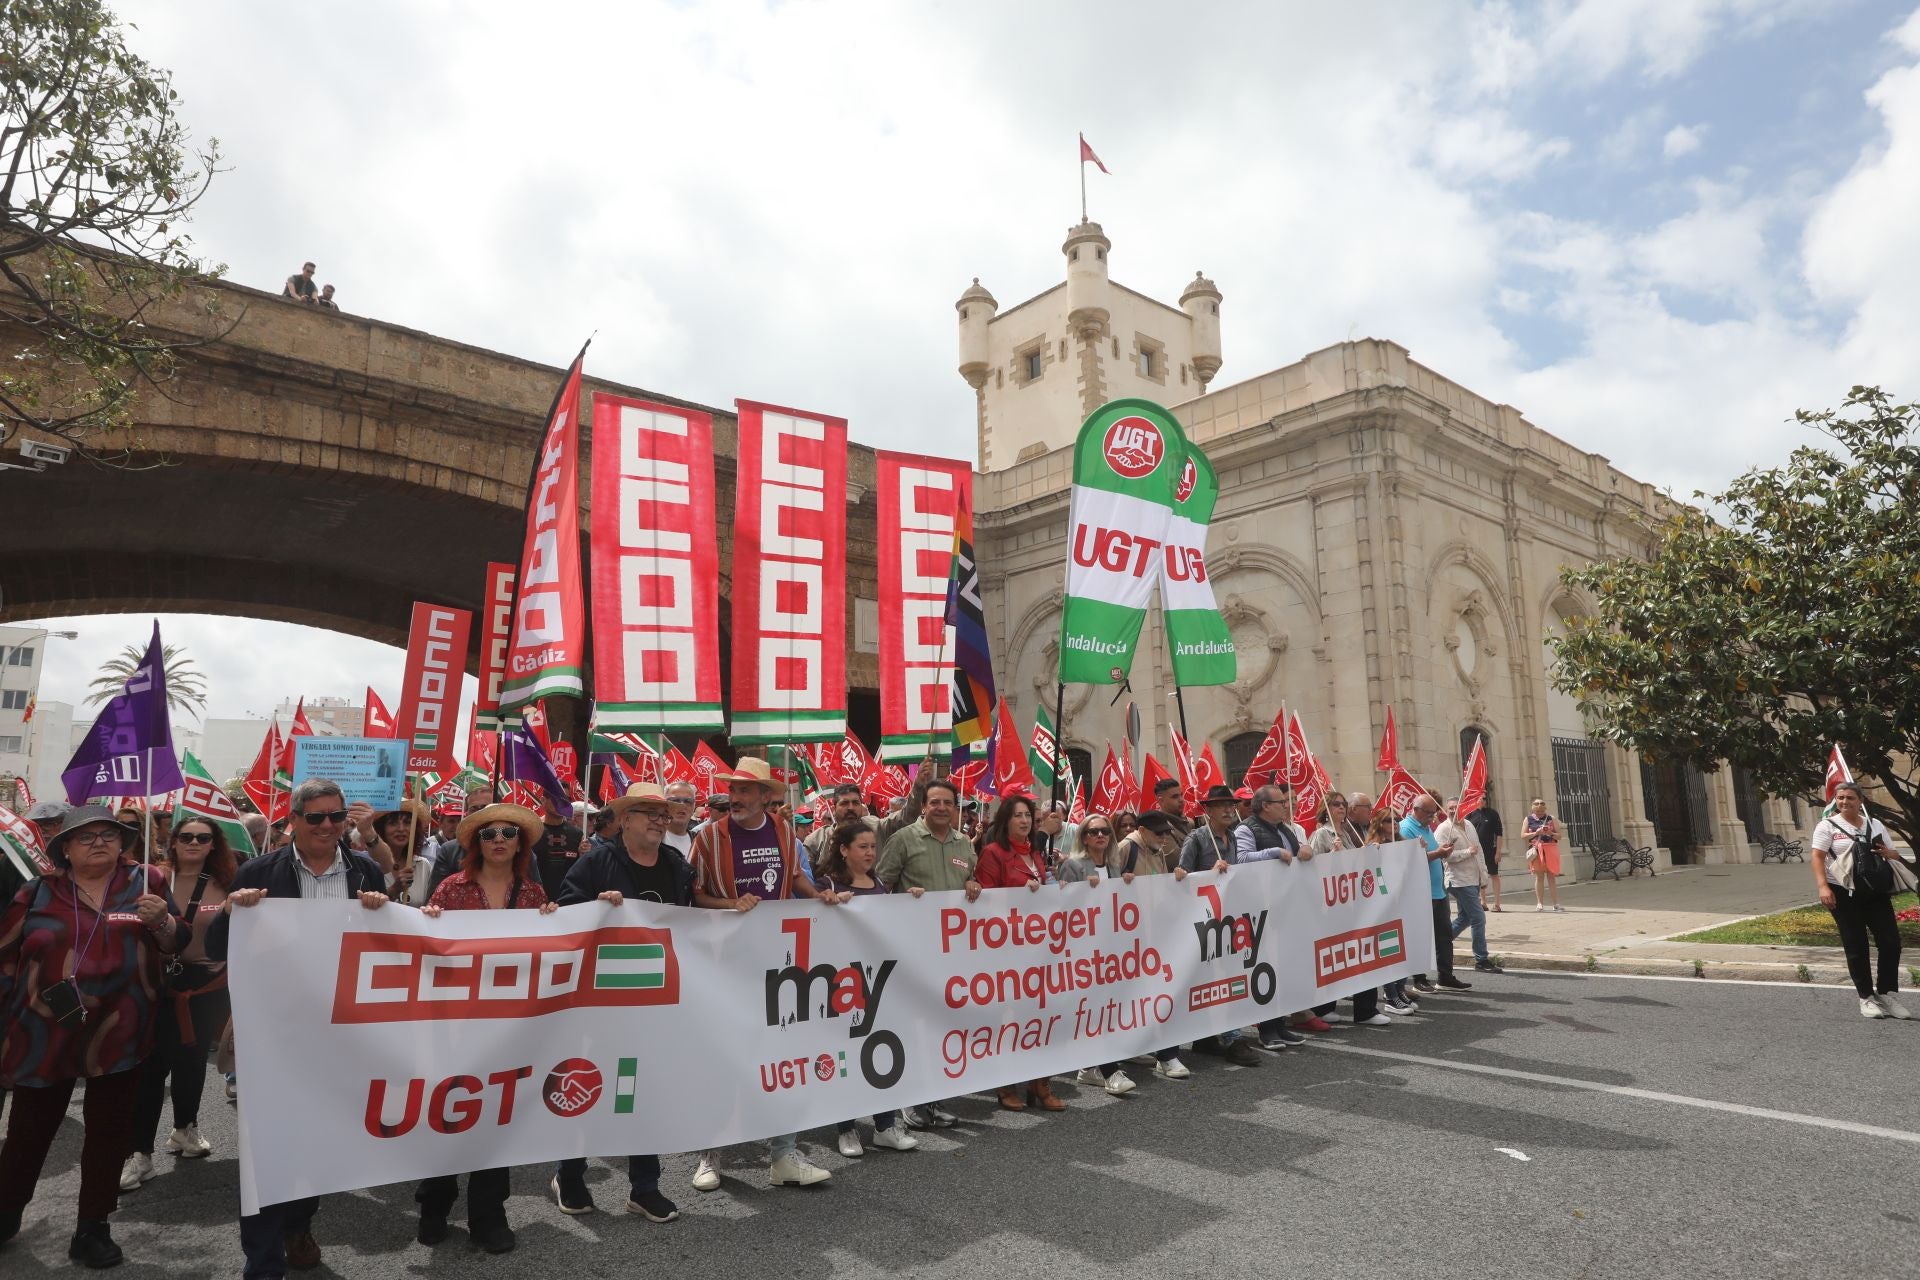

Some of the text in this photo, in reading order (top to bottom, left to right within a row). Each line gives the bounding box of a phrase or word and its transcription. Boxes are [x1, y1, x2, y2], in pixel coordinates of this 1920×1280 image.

[1111, 424, 1158, 456] UGT
[619, 405, 696, 702] CCOO
[758, 410, 824, 709] CCOO
[1073, 523, 1161, 578] UGT
[1165, 544, 1207, 584] UG
[899, 466, 956, 732] CCOO
[513, 649, 566, 673] Cádiz
[1176, 638, 1235, 656] Andalucía
[415, 610, 455, 730] CCOO
[301, 742, 376, 752] VERGARA SOMOS TODOS
[409, 756, 437, 768] Cádiz
[743, 856, 780, 865] enseñanza
[1323, 871, 1358, 907] UGT
[940, 892, 1140, 954] Proteger lo
[354, 949, 586, 1004] CCOO
[944, 938, 1173, 1010] conquistado,
[1319, 935, 1376, 977] CCOO
[1191, 983, 1230, 1007] CCOO
[942, 993, 1174, 1079] ganar futuro
[760, 1057, 809, 1093] UGT
[363, 1065, 533, 1139] UGT
